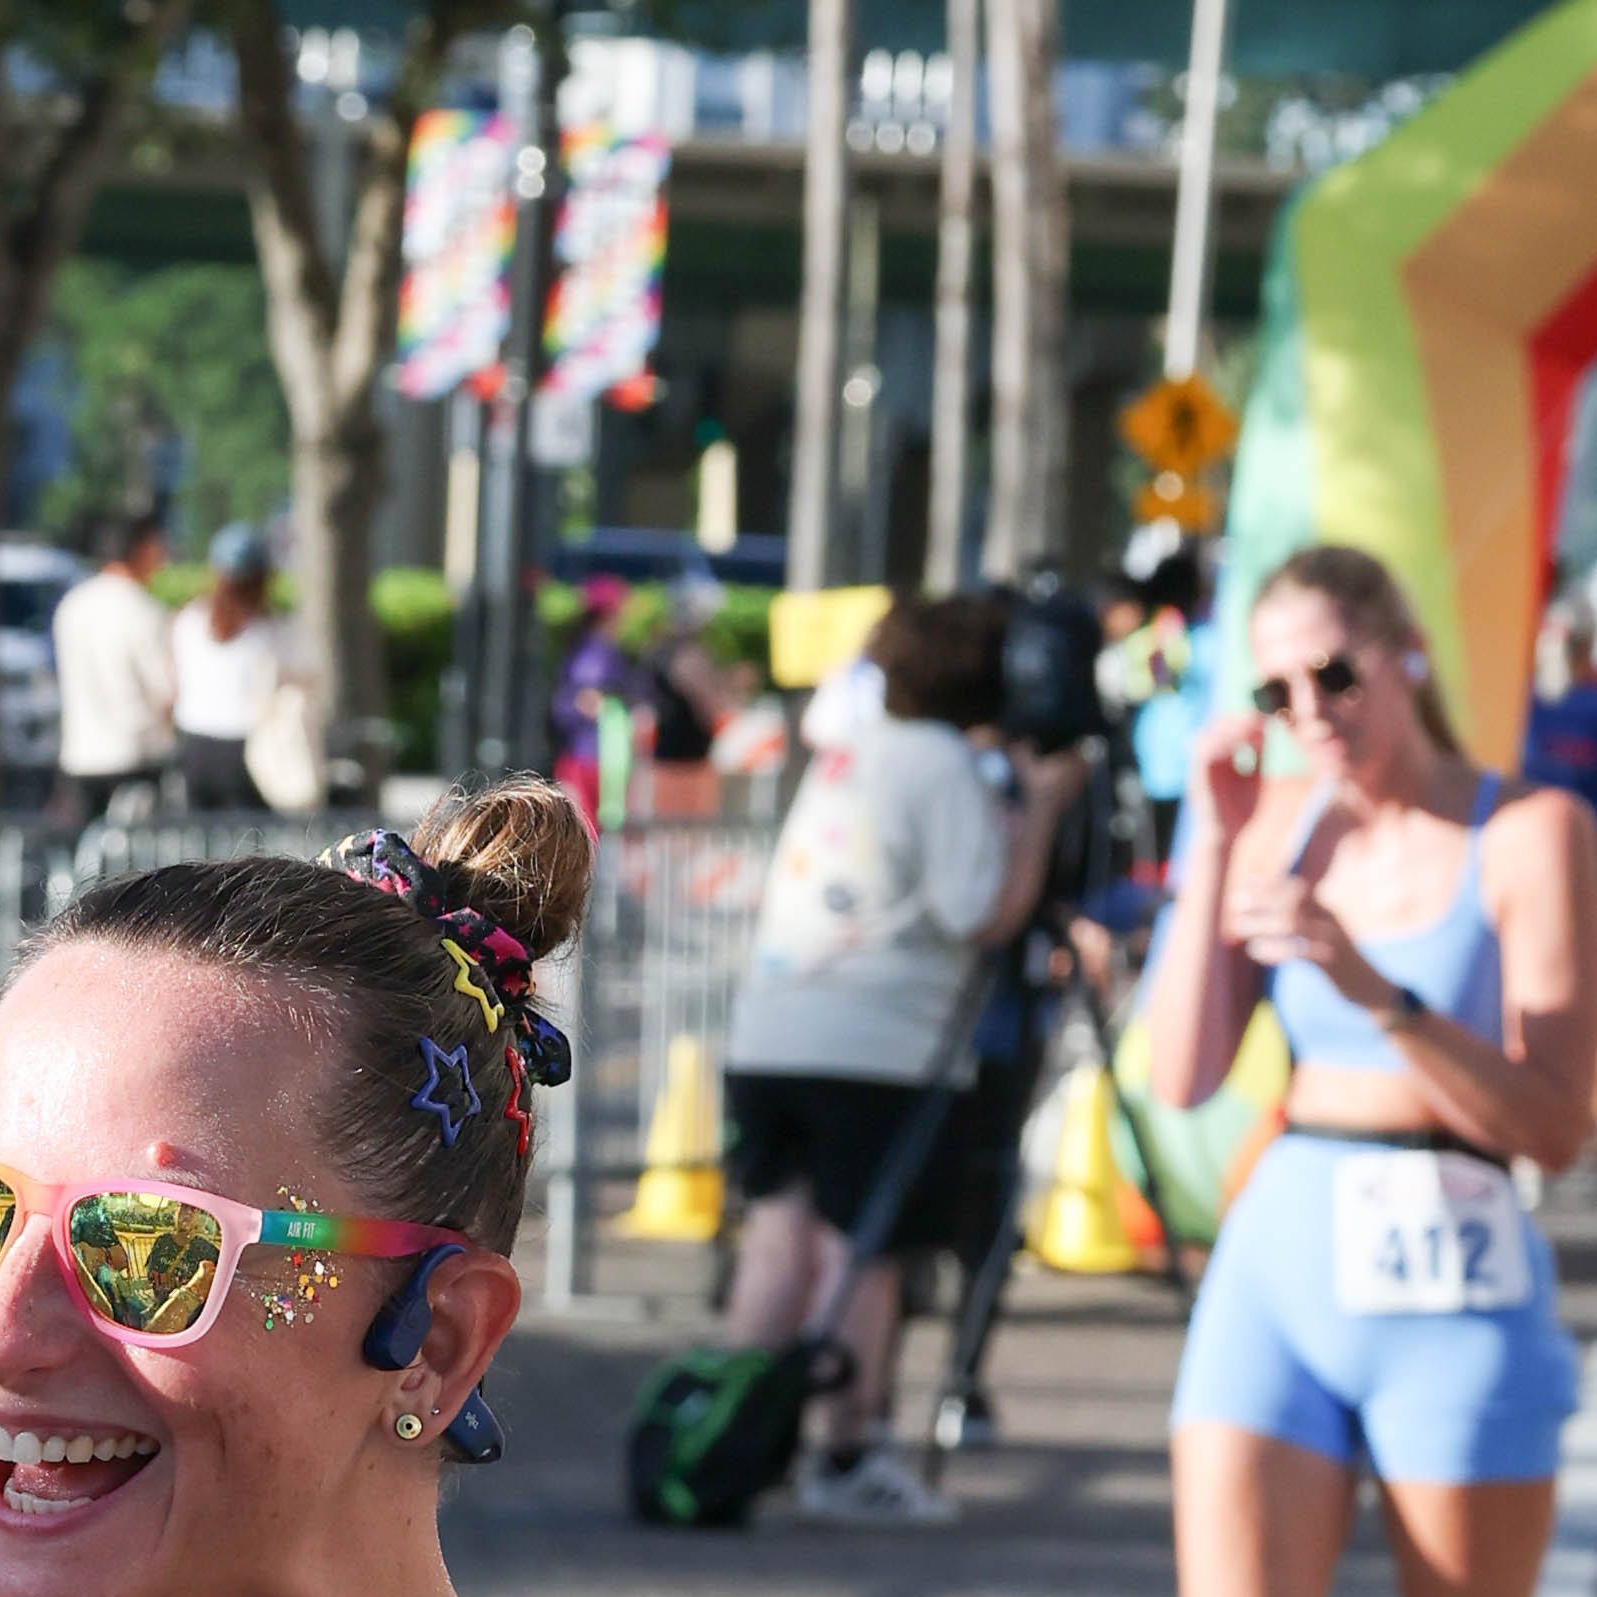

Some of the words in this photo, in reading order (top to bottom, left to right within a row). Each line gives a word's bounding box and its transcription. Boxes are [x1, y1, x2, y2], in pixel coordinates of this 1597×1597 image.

[287, 1221, 301, 1238] AIR
[303, 1222, 316, 1239] FIT
[1372, 1217, 1494, 1286] 412
